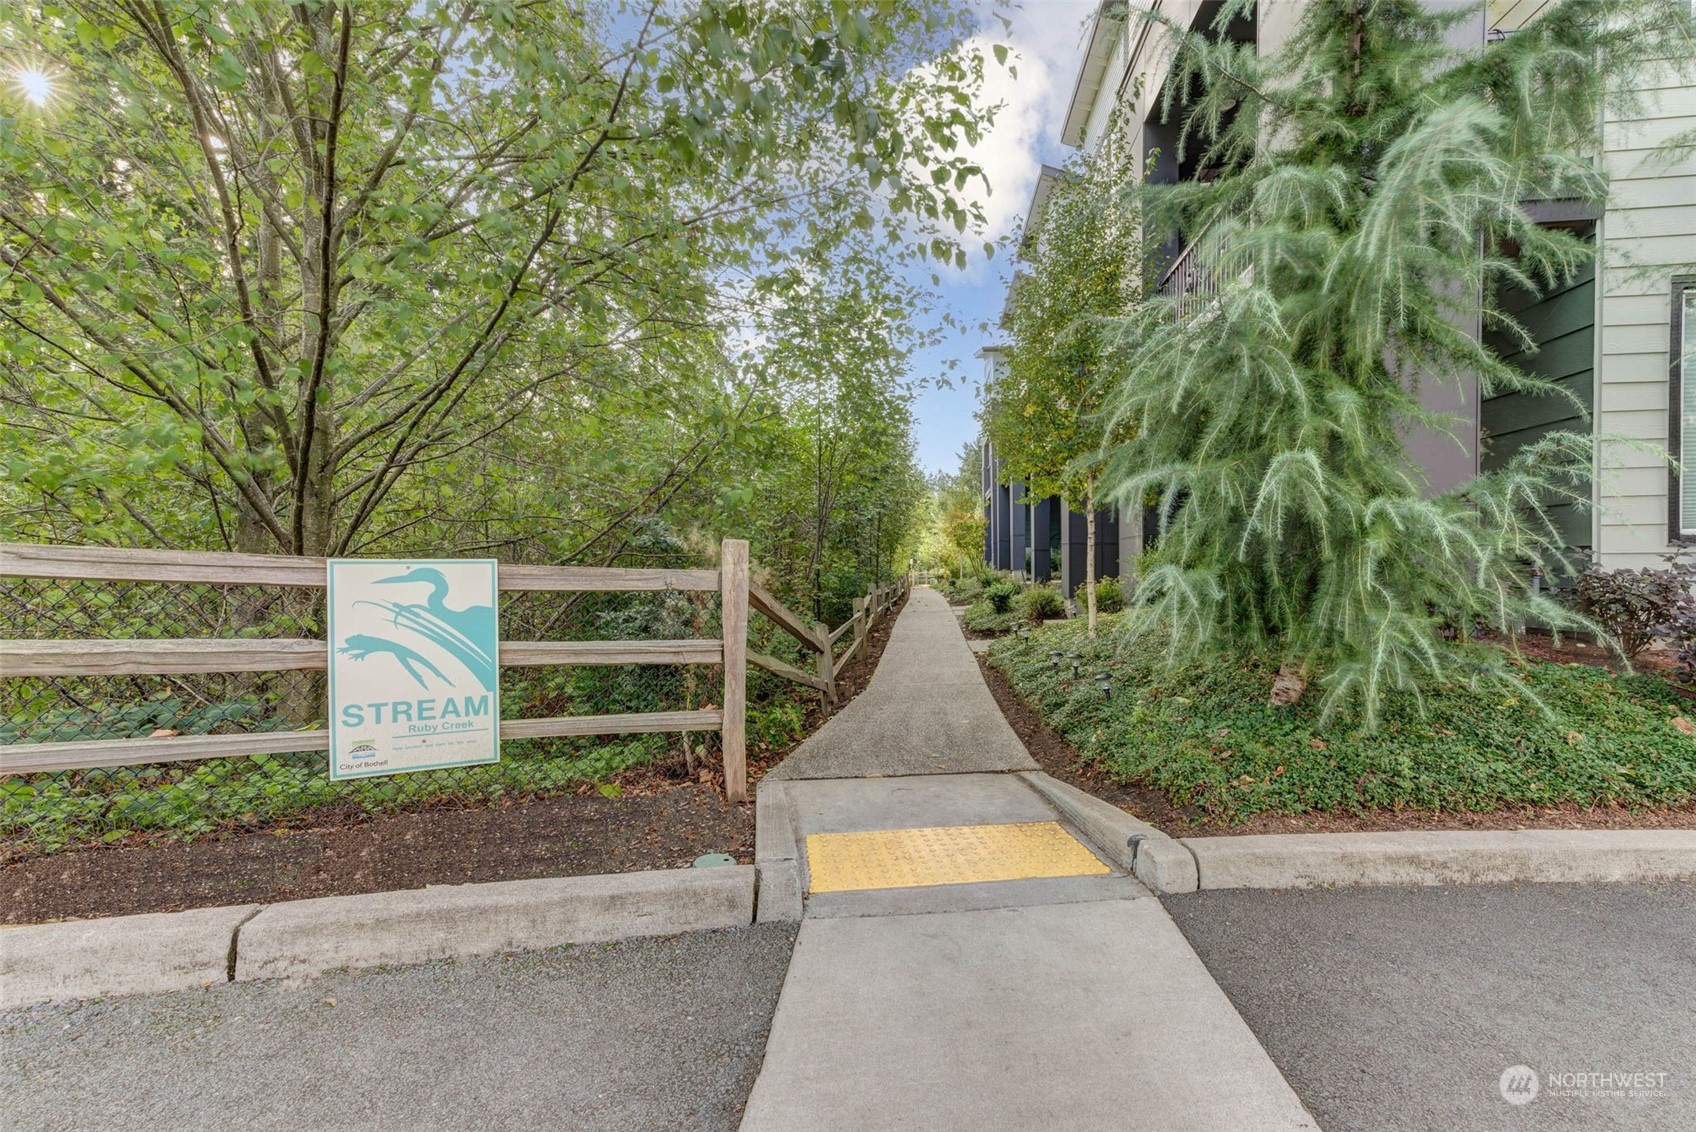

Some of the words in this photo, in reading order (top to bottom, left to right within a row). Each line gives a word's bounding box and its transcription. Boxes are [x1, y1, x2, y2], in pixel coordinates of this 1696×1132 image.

[341, 694, 489, 728] STREAM
[408, 723, 439, 734] Ruby
[442, 719, 474, 731] Creek
[339, 763, 354, 771] City
[364, 759, 389, 768] Bothell
